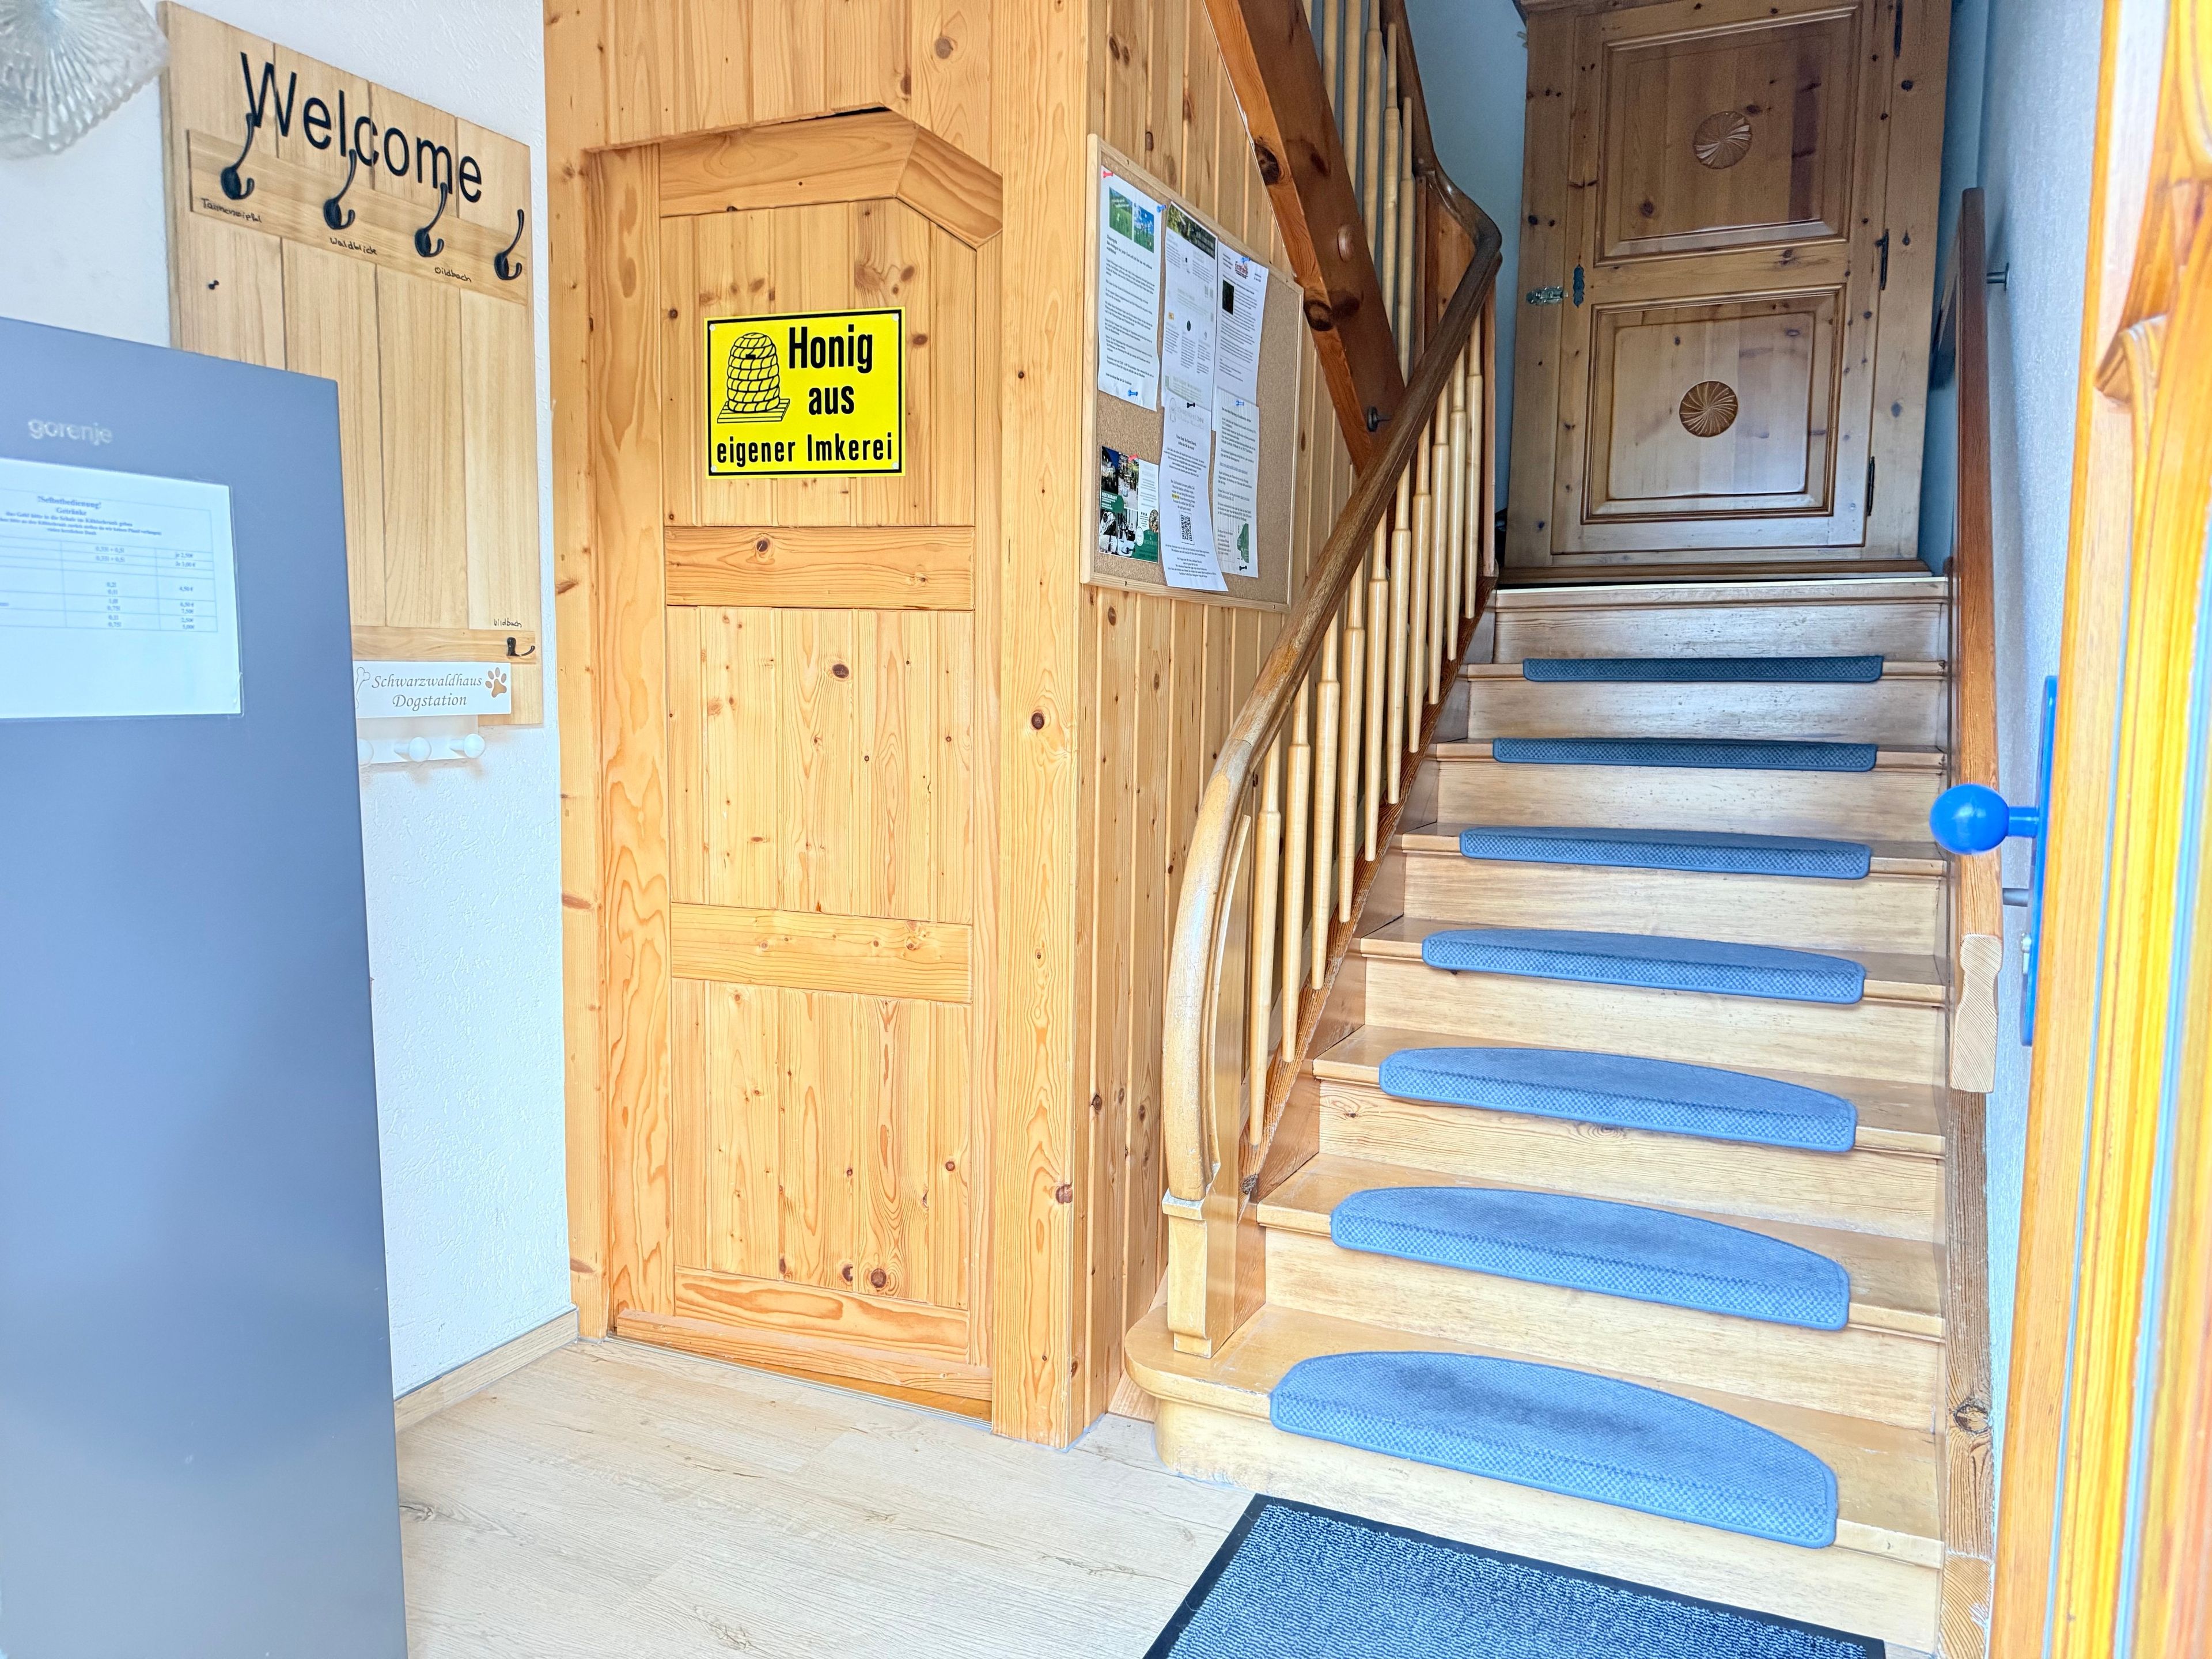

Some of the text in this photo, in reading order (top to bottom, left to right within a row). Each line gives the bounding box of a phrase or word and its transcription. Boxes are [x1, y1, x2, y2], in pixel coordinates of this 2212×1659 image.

[240, 51, 482, 203] Welcome
[329, 237, 378, 255] Waldblick
[789, 324, 873, 373] Honig
[809, 385, 854, 415] aus
[28, 419, 112, 445] gorenje
[717, 432, 892, 467] eigener Imkerei
[372, 673, 482, 688] Schwarzwaldhaus
[392, 693, 467, 711] Dogstation
